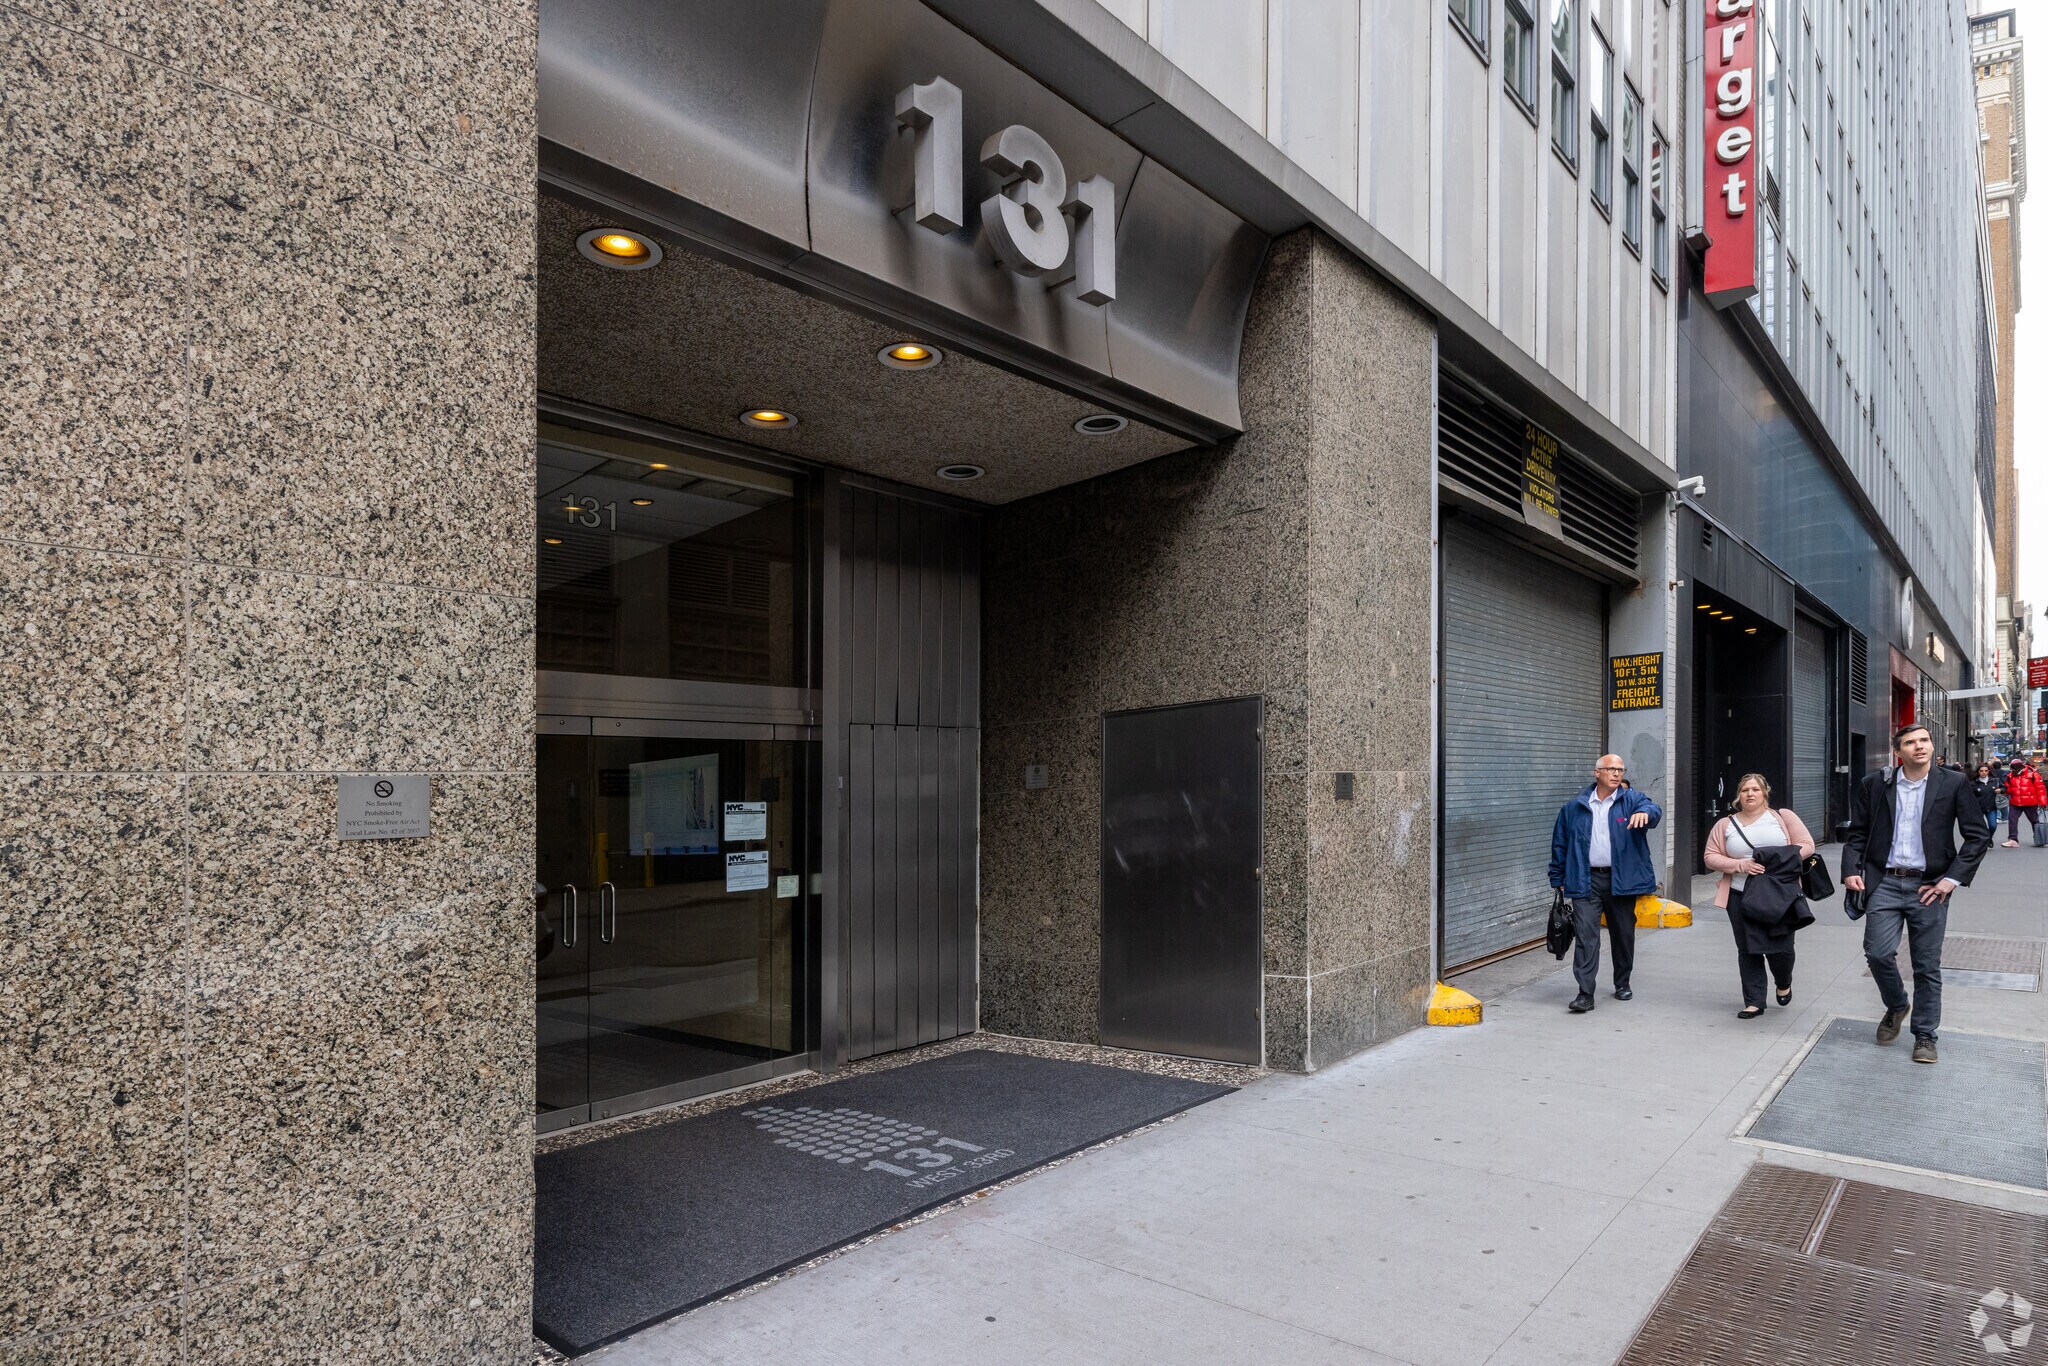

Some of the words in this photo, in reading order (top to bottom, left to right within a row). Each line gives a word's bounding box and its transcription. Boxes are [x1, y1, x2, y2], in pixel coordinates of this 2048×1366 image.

[895, 75, 1116, 307] 131
[1526, 423, 1536, 442] 24
[1537, 430, 1558, 458] HOUR
[1531, 445, 1552, 469] ACTIVE
[1526, 457, 1557, 486] DRIVEWAY
[1523, 491, 1535, 505] WILL
[1535, 498, 1543, 510] BE
[1543, 502, 1559, 519] TOWED
[1528, 481, 1555, 505] VIOLATORS
[560, 492, 618, 532] 131
[1633, 654, 1660, 666] HEIGHT
[1616, 679, 1627, 687] 131
[1628, 678, 1637, 686] W.
[1637, 677, 1647, 685] 33
[1647, 676, 1657, 684] ST.
[1616, 686, 1656, 698] FREIGHT
[1612, 696, 1660, 708] ENTRANCE
[727, 803, 744, 811] NYC
[728, 854, 746, 862] NYC
[862, 1136, 987, 1178] 131
[905, 1165, 965, 1188] WEST
[963, 1149, 1016, 1169] 33RD
